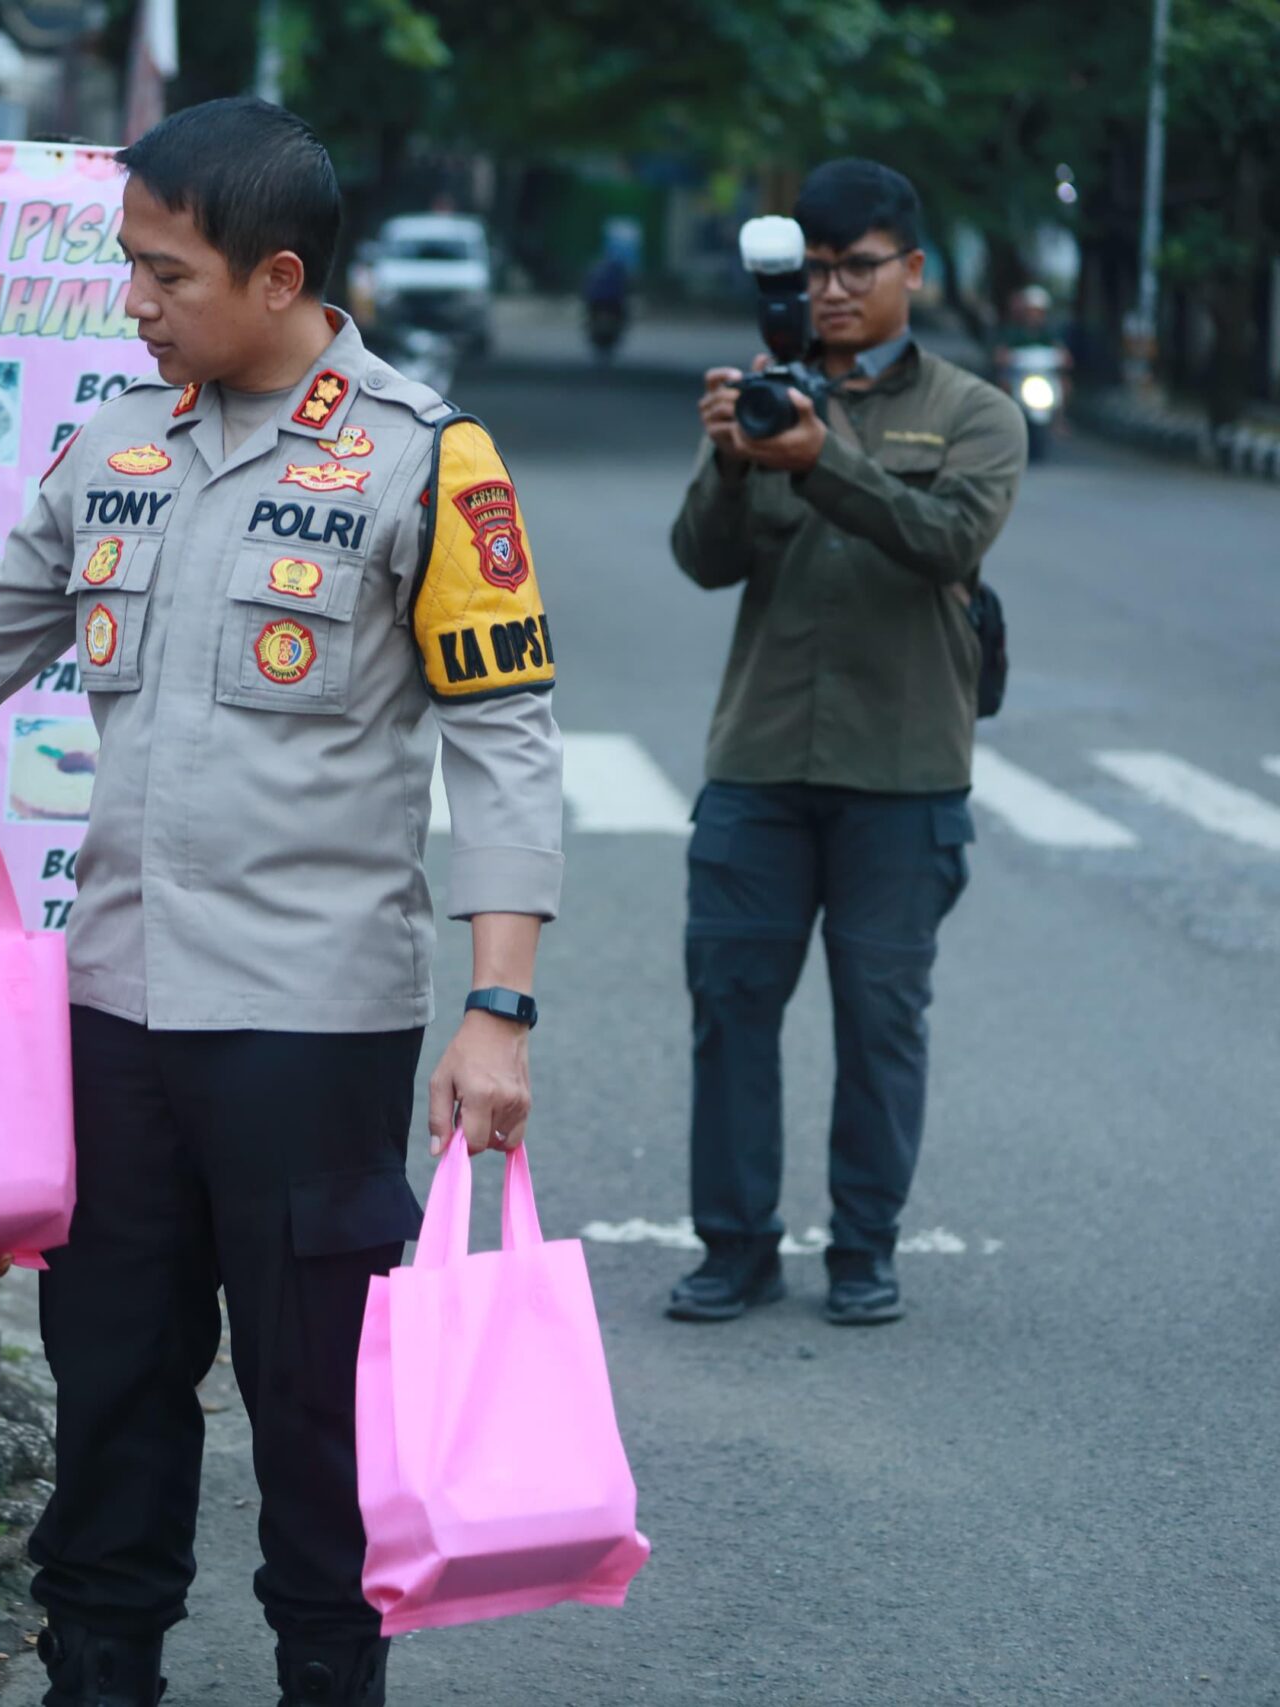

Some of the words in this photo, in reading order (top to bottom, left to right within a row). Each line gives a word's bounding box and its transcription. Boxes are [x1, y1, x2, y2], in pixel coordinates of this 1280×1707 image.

[9, 200, 128, 264] PISA
[74, 373, 138, 403] BO
[85, 490, 172, 525] TONY
[248, 500, 367, 550] POLRI
[438, 627, 489, 683] KA
[35, 661, 83, 694] PA
